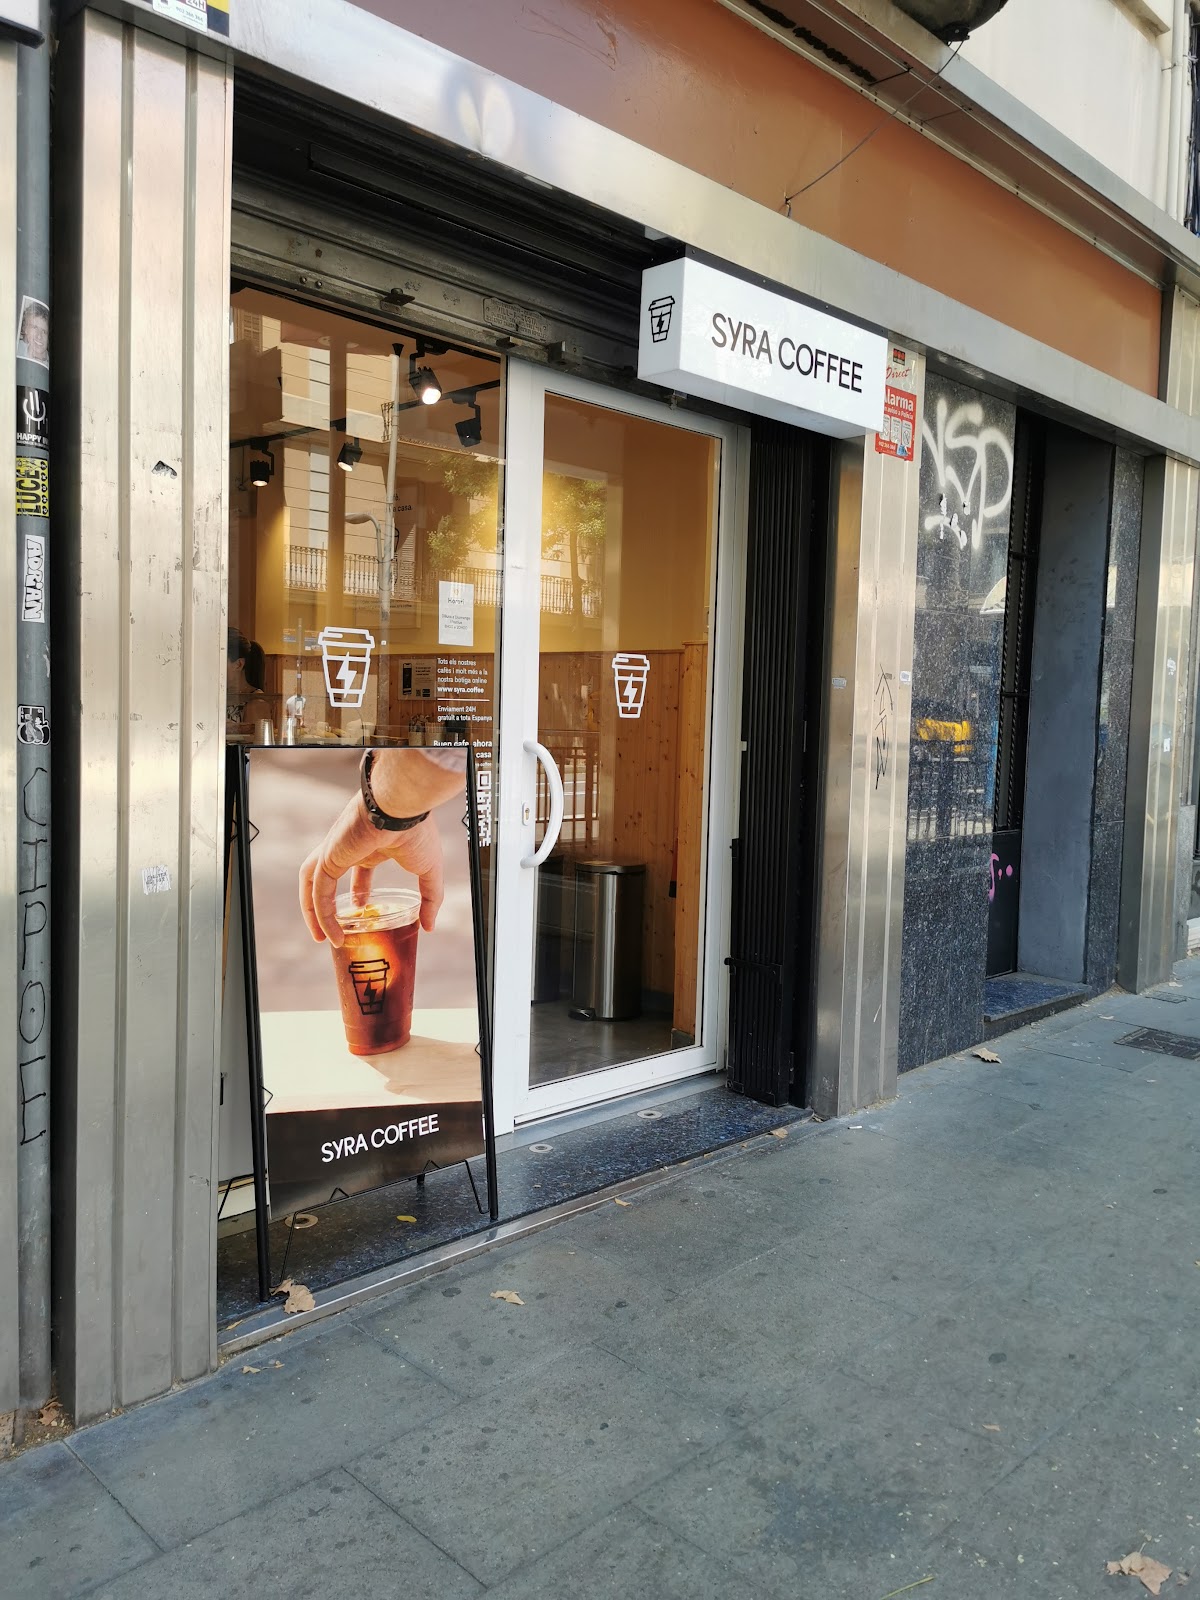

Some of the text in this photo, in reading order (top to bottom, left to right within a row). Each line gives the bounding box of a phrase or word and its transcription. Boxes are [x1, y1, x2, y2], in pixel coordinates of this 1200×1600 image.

[711, 312, 863, 393] SYRA COFFEE
[16, 432, 42, 443] HAPPY
[454, 676, 471, 684] botiga
[472, 739, 493, 748] ahora
[320, 1113, 440, 1163] SYRA COFFEE
